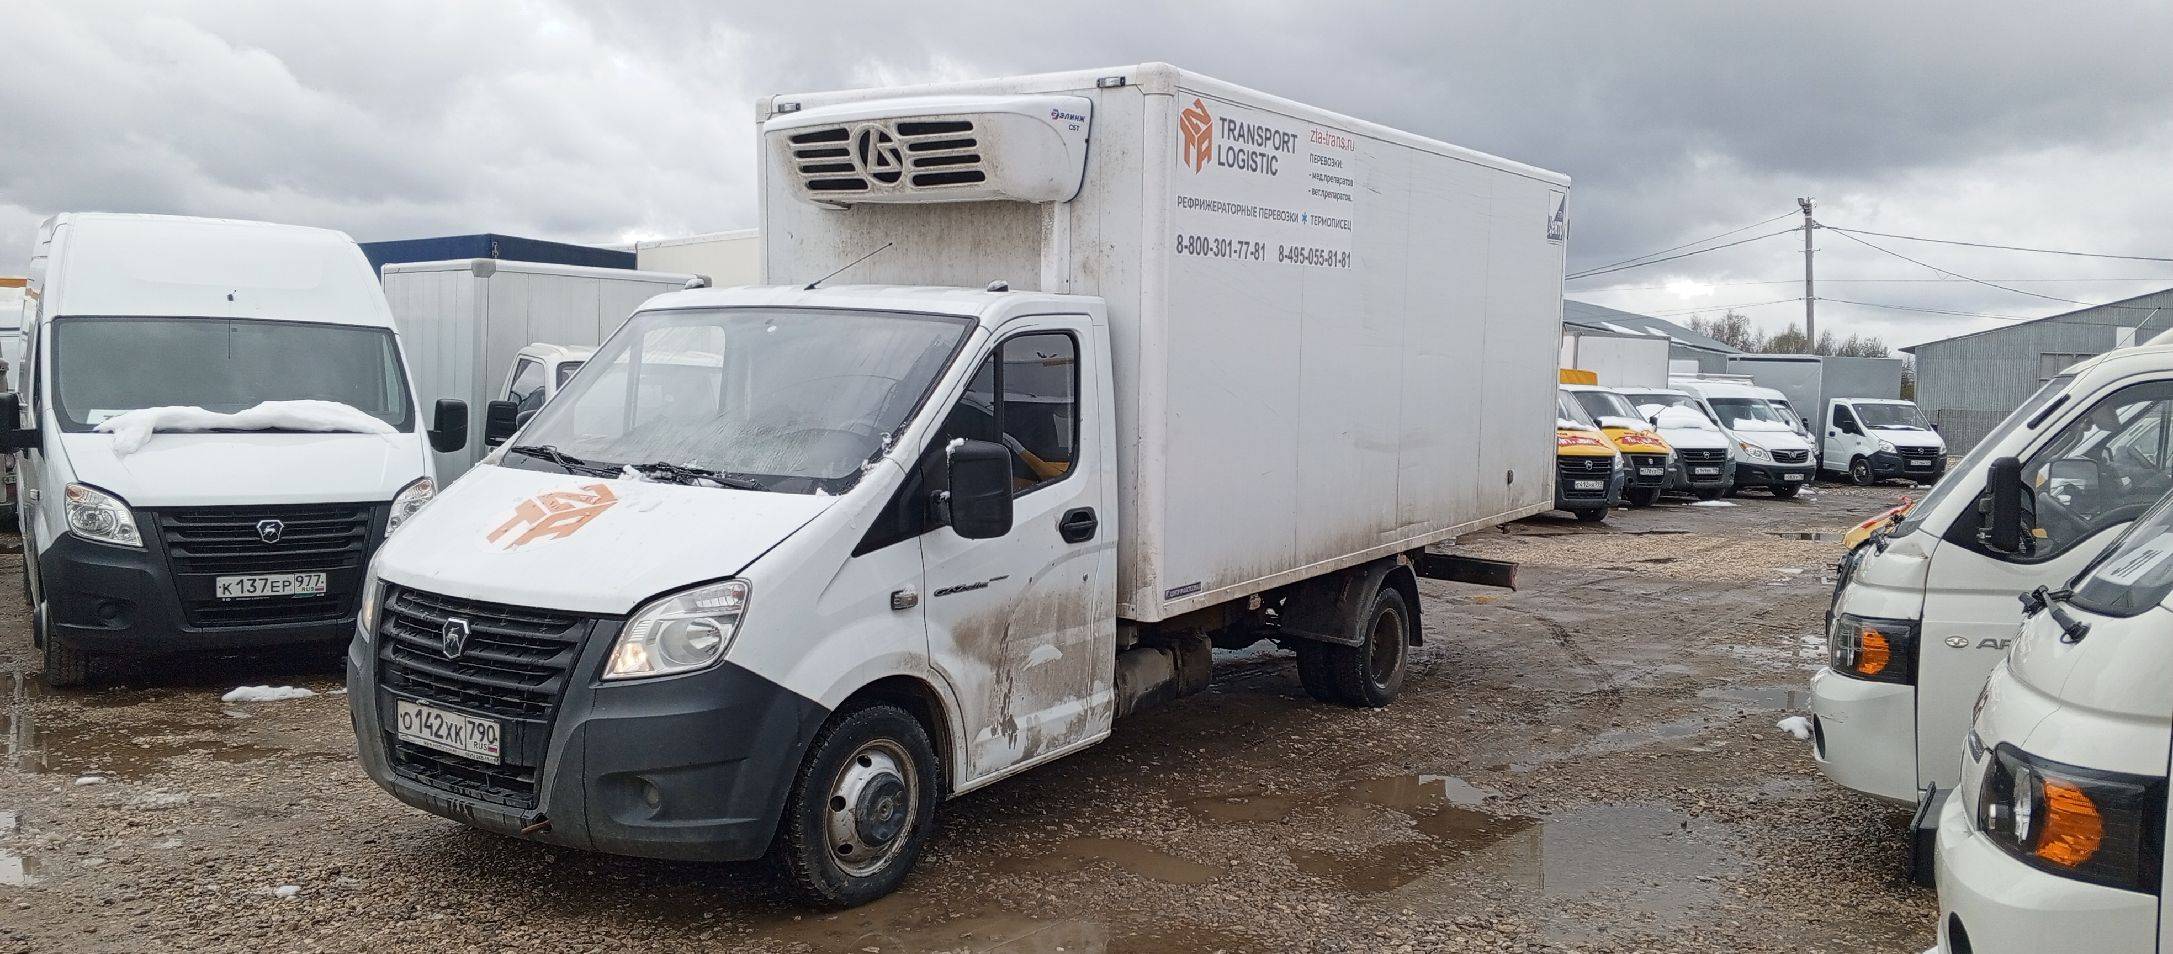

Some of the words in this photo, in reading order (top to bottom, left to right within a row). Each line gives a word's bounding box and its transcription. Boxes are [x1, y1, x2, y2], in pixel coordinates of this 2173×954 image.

[1219, 116, 1298, 154] TRANSPORT
[1217, 144, 1279, 176] LOGISTIC
[1177, 195, 1257, 218] РЕФРИЖЕРАТОРНЫЕ
[1258, 207, 1299, 223] ПЕРЕВОЗКИ
[1310, 214, 1352, 232] ТЕРМОПИСЕЦ
[1176, 234, 1266, 261] 8-800-301-77-81
[1278, 245, 1352, 268] 8-495-055-81-81
[296, 574, 321, 588] 977
[467, 720, 496, 744] 790
[473, 741, 487, 751] RUS
